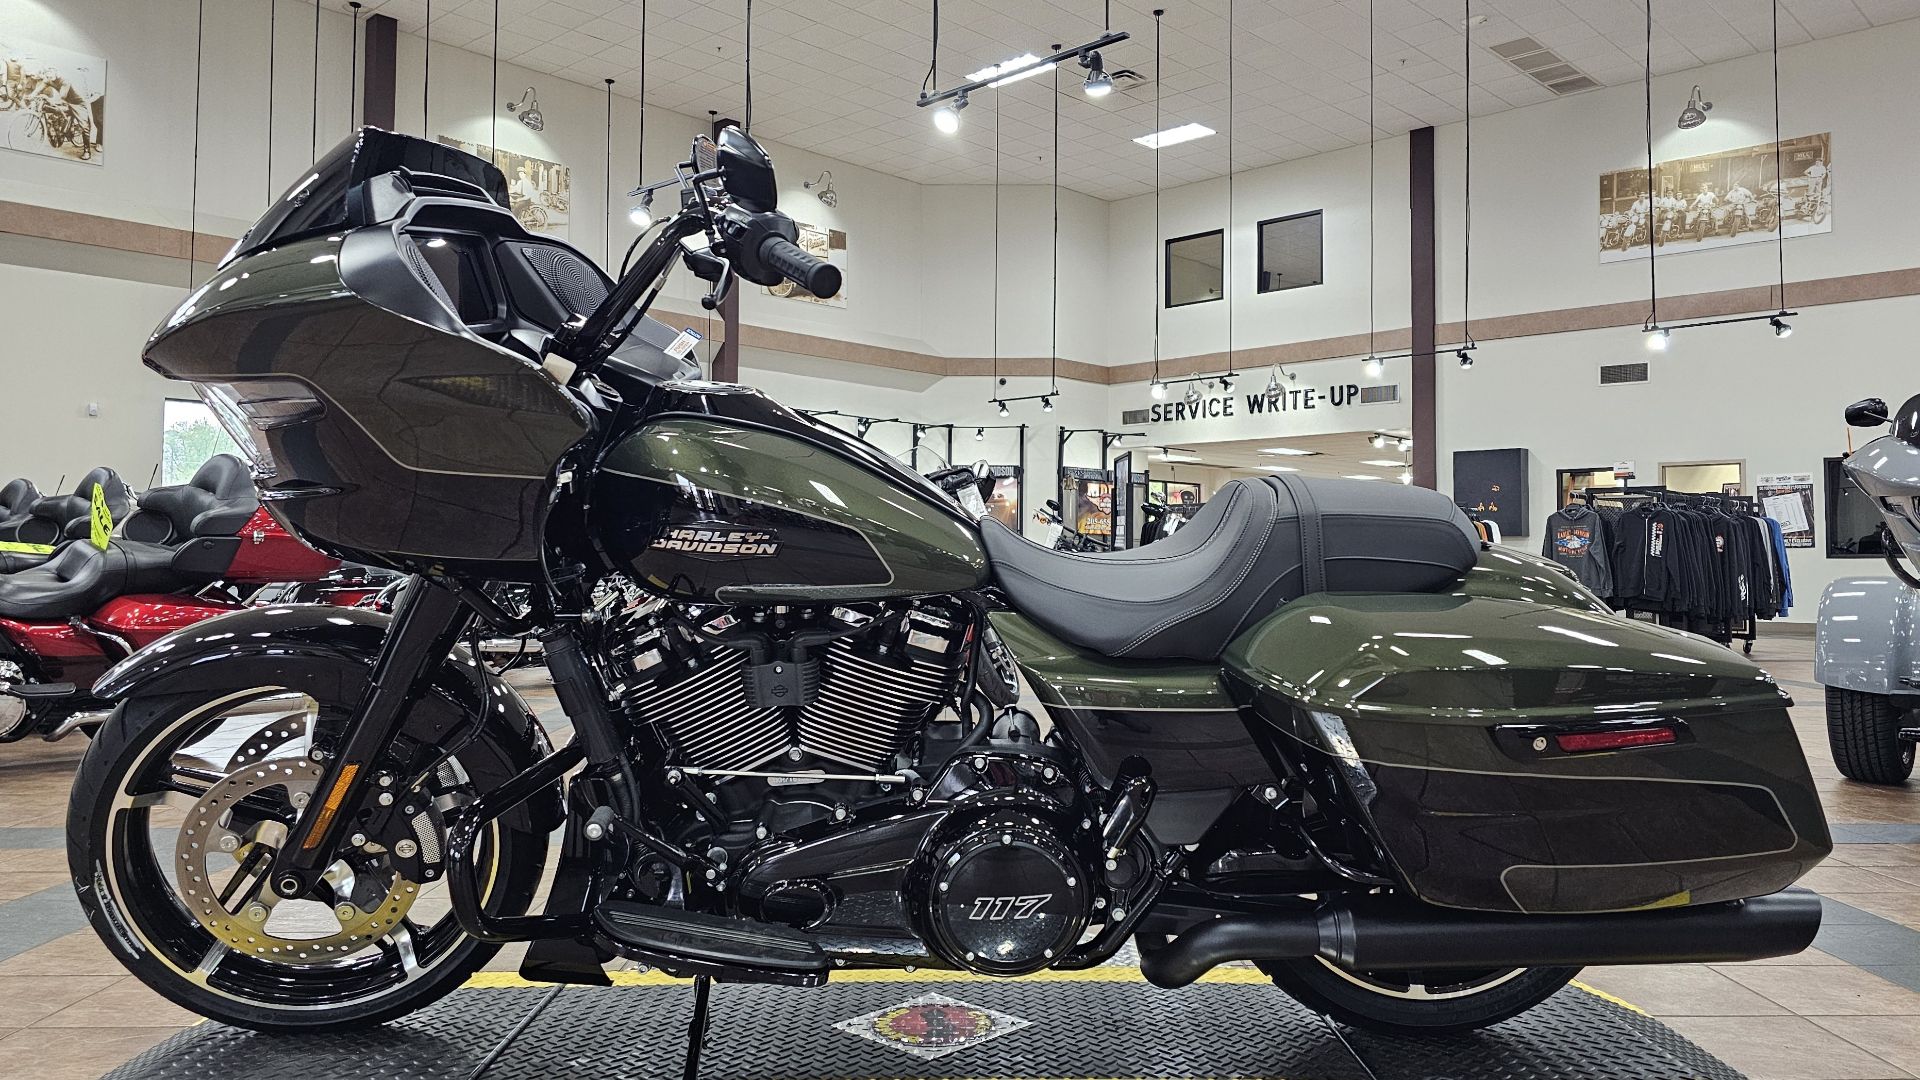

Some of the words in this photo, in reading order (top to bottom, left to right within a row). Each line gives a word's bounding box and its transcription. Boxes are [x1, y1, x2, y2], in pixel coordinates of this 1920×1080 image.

[1150, 397, 1234, 422] SERVICE
[1246, 384, 1359, 414] WRITE-UP
[651, 539, 778, 554] DAVIDSON
[969, 894, 1052, 920] 117
